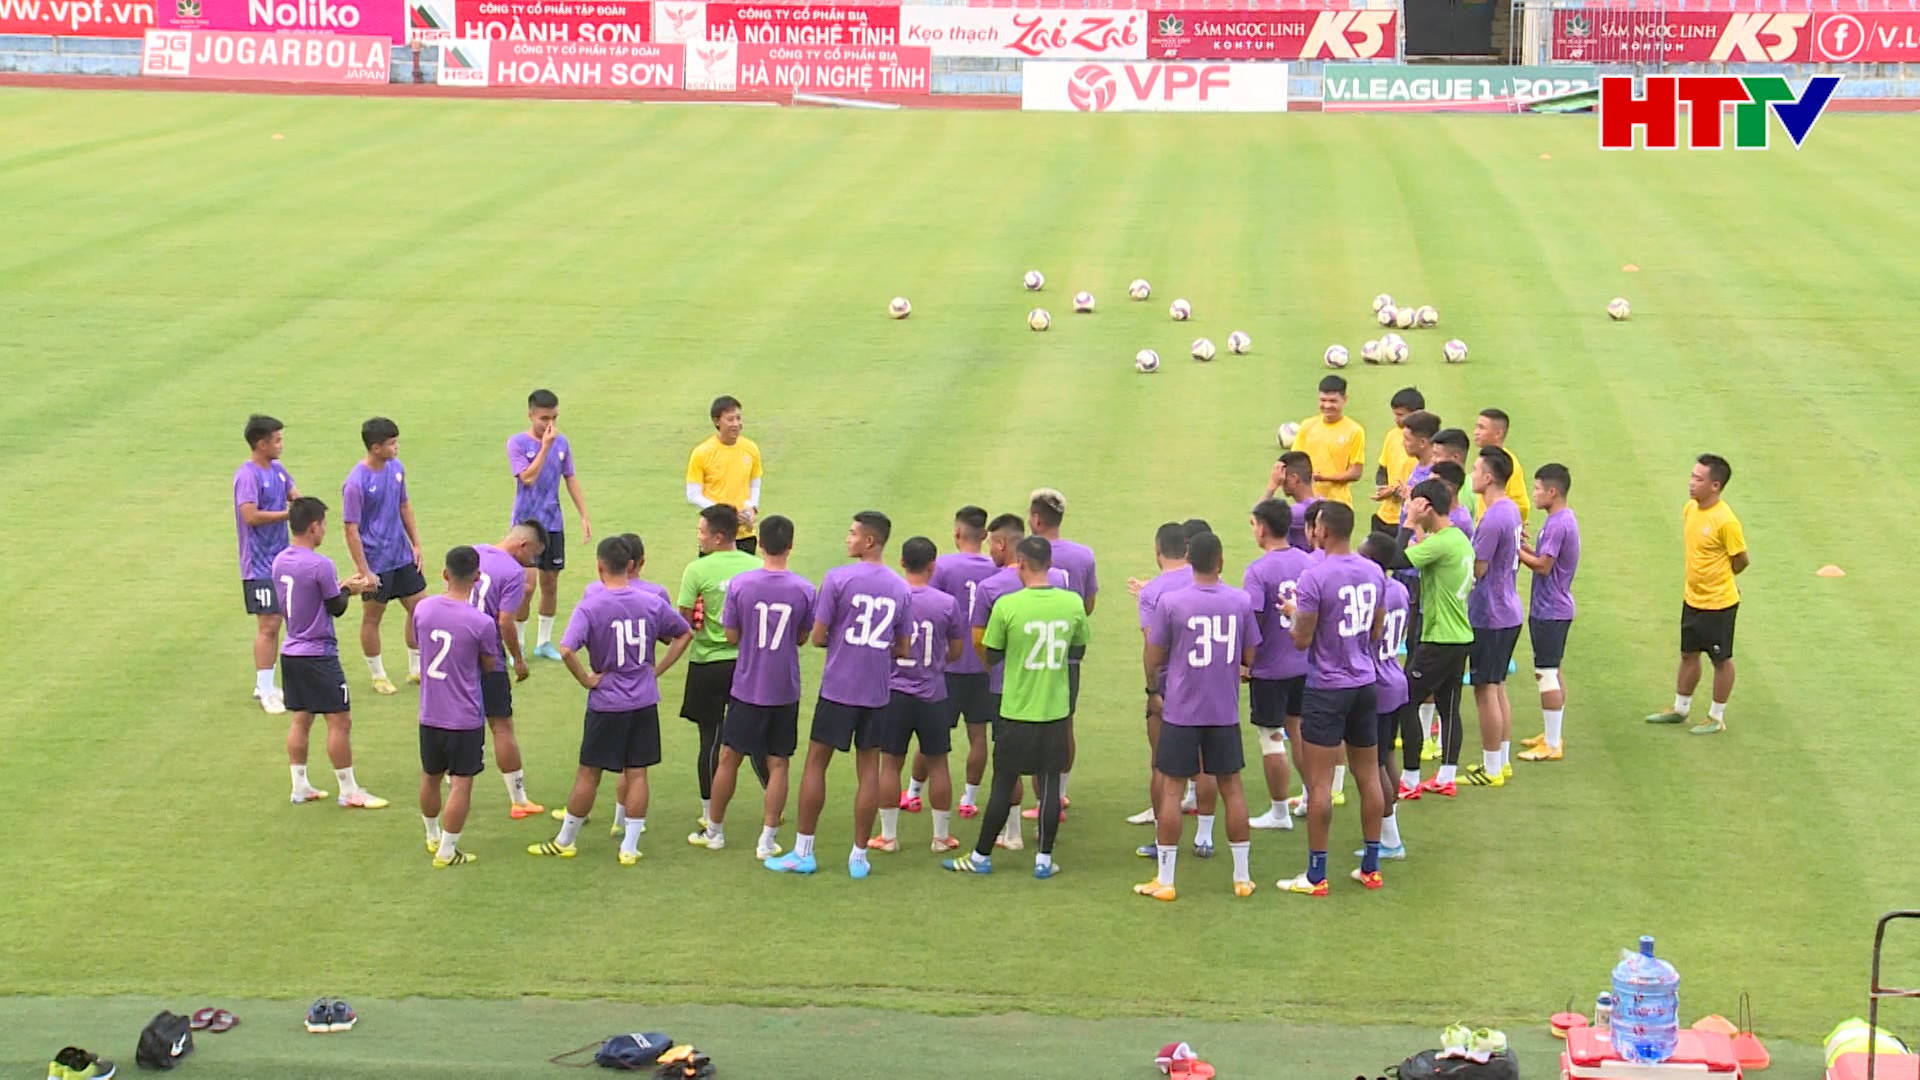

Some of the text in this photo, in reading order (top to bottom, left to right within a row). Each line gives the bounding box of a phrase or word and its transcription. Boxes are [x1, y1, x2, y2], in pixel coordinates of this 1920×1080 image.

[249, 0, 360, 28] Noliko
[511, 4, 525, 14] TY
[775, 10, 790, 20] TY
[465, 15, 568, 42] HOÀNH
[1270, 23, 1305, 37] LINH
[1299, 11, 1395, 59] K5
[1680, 25, 1717, 39] LINH
[1709, 13, 1811, 62] K5
[195, 35, 386, 69] JOGARBOLA
[546, 45, 558, 55] TY
[807, 50, 821, 60] TY
[344, 68, 386, 81] JAPAN
[444, 69, 484, 80] HSG
[498, 56, 674, 86] HOÀNH SƠN
[741, 59, 769, 85] HÀ
[1124, 65, 1231, 101] VPF
[1327, 79, 1473, 100] V.LEAGUE
[1478, 79, 1495, 100] 1
[280, 575, 294, 619] 7
[1338, 583, 1377, 637] 38
[755, 602, 793, 651] 17
[845, 594, 897, 650] 32
[427, 629, 453, 681] 2
[611, 618, 647, 668] 14
[1023, 620, 1069, 671] 26
[1187, 615, 1238, 668] 34
